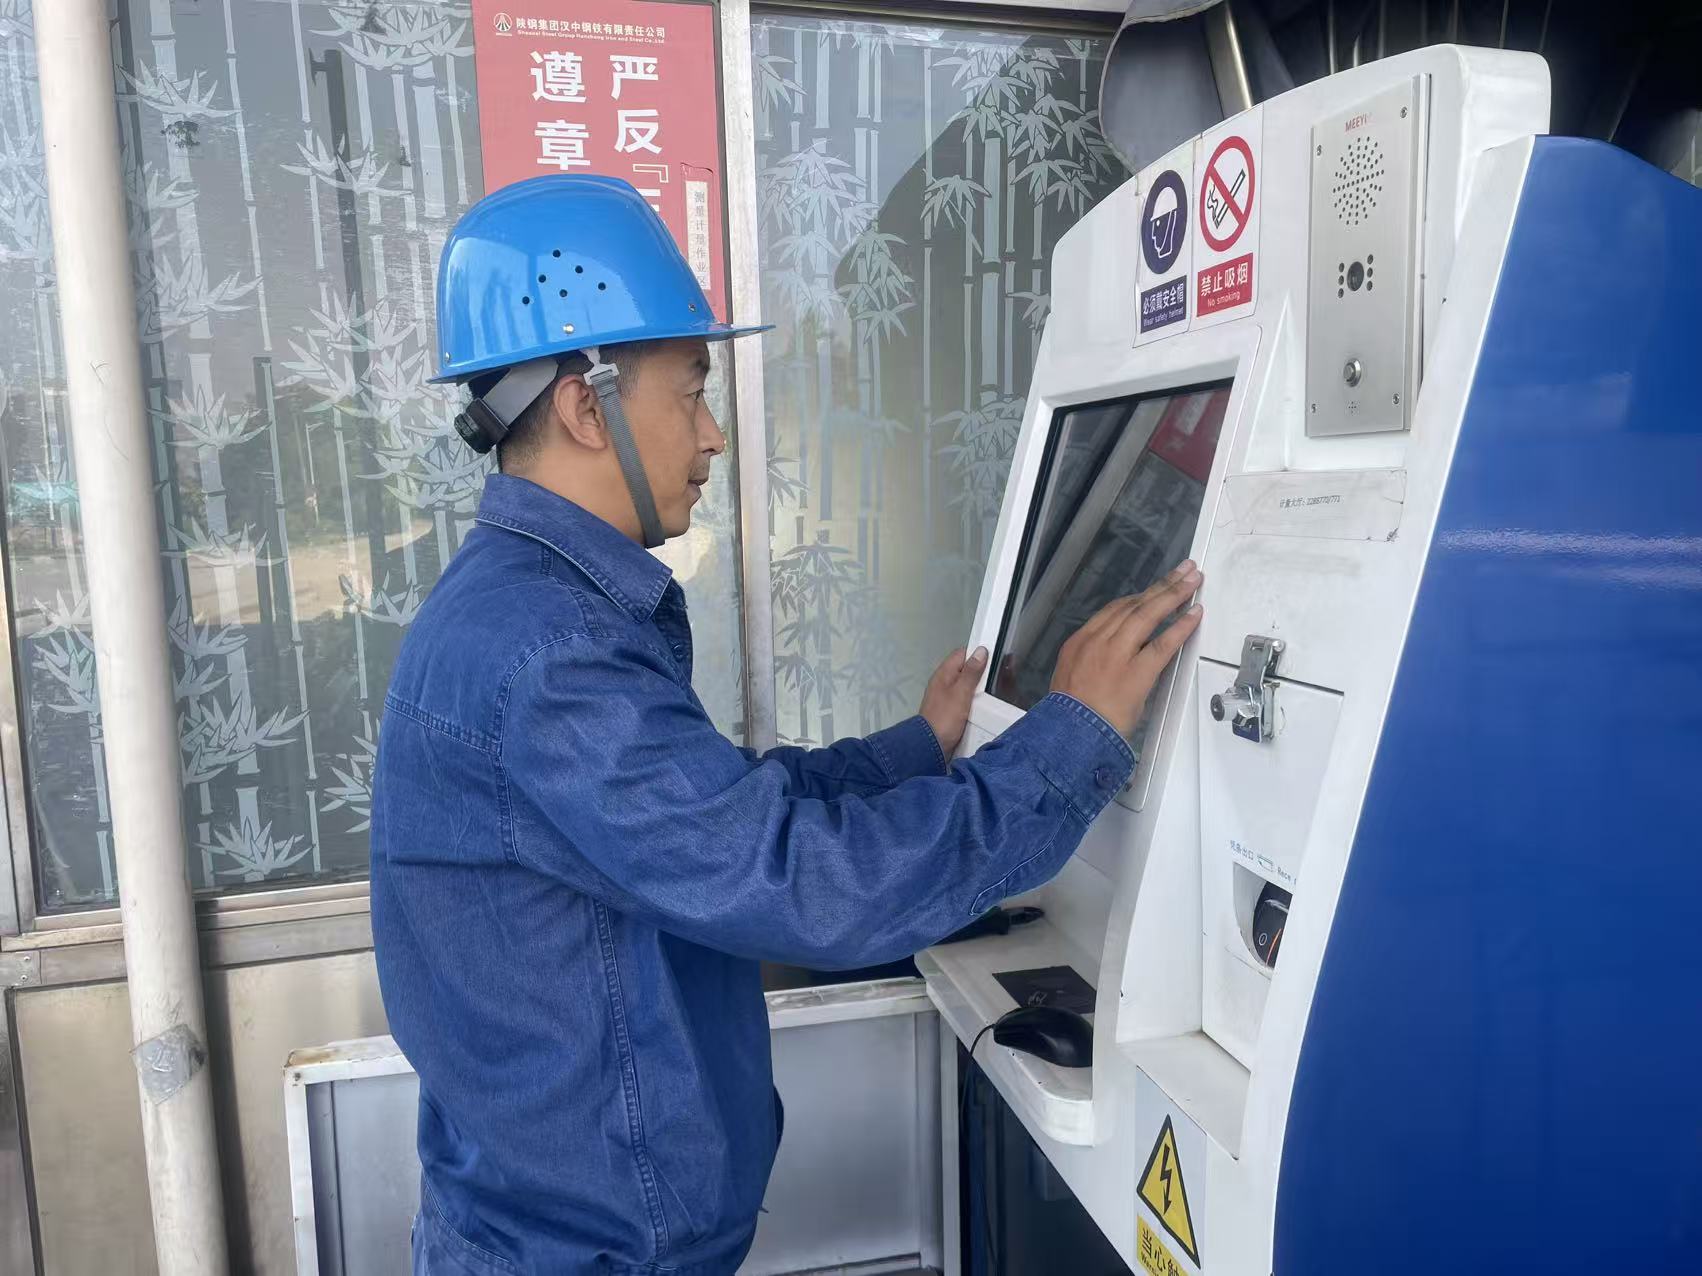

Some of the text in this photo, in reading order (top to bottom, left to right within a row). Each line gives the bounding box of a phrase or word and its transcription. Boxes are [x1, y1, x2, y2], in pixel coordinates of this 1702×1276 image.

[516, 17, 665, 38] 陕钢集团汉中钢铁有限责任公司
[530, 51, 591, 171] 遵章
[1200, 262, 1249, 296] 禁止吸烟
[1143, 282, 1184, 315] 必须戴安全帽
[1208, 291, 1241, 308] No smoking
